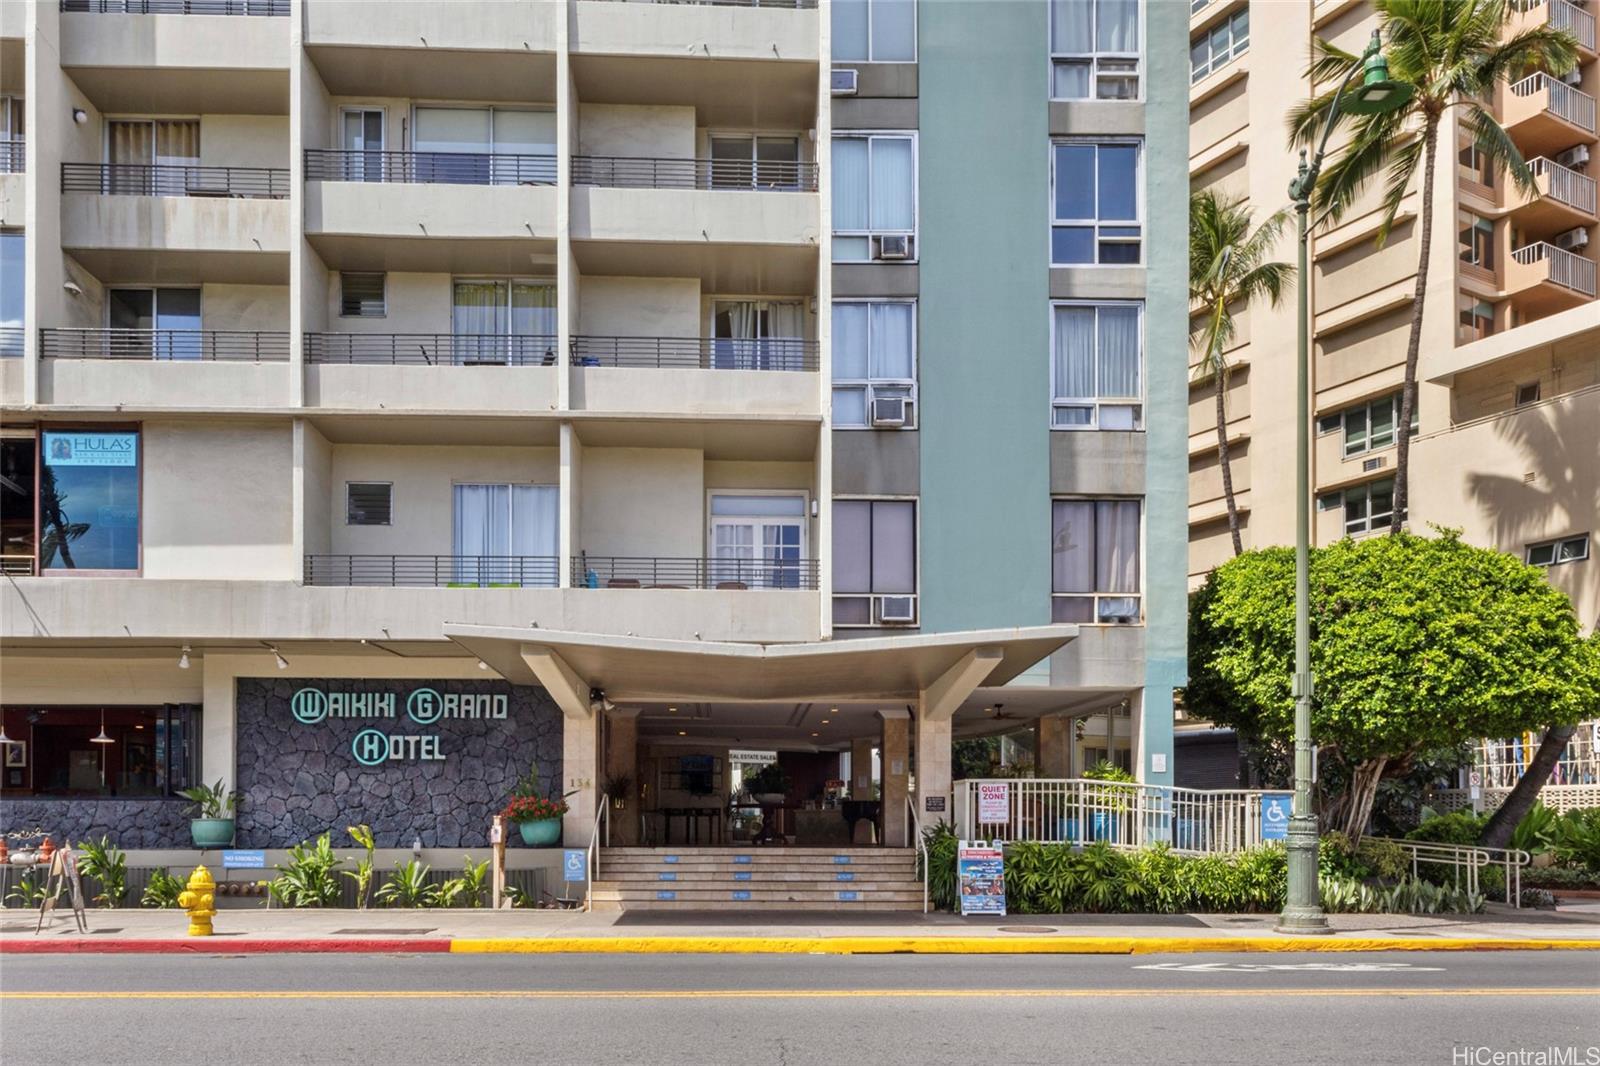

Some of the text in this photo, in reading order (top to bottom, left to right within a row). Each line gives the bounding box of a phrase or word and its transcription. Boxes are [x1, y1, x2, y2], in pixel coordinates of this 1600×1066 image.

[74, 438, 131, 450] HULA'S
[297, 691, 508, 720] WAIKIKI GRAND
[359, 733, 446, 761] HOTEL
[981, 785, 1007, 793] QUIET
